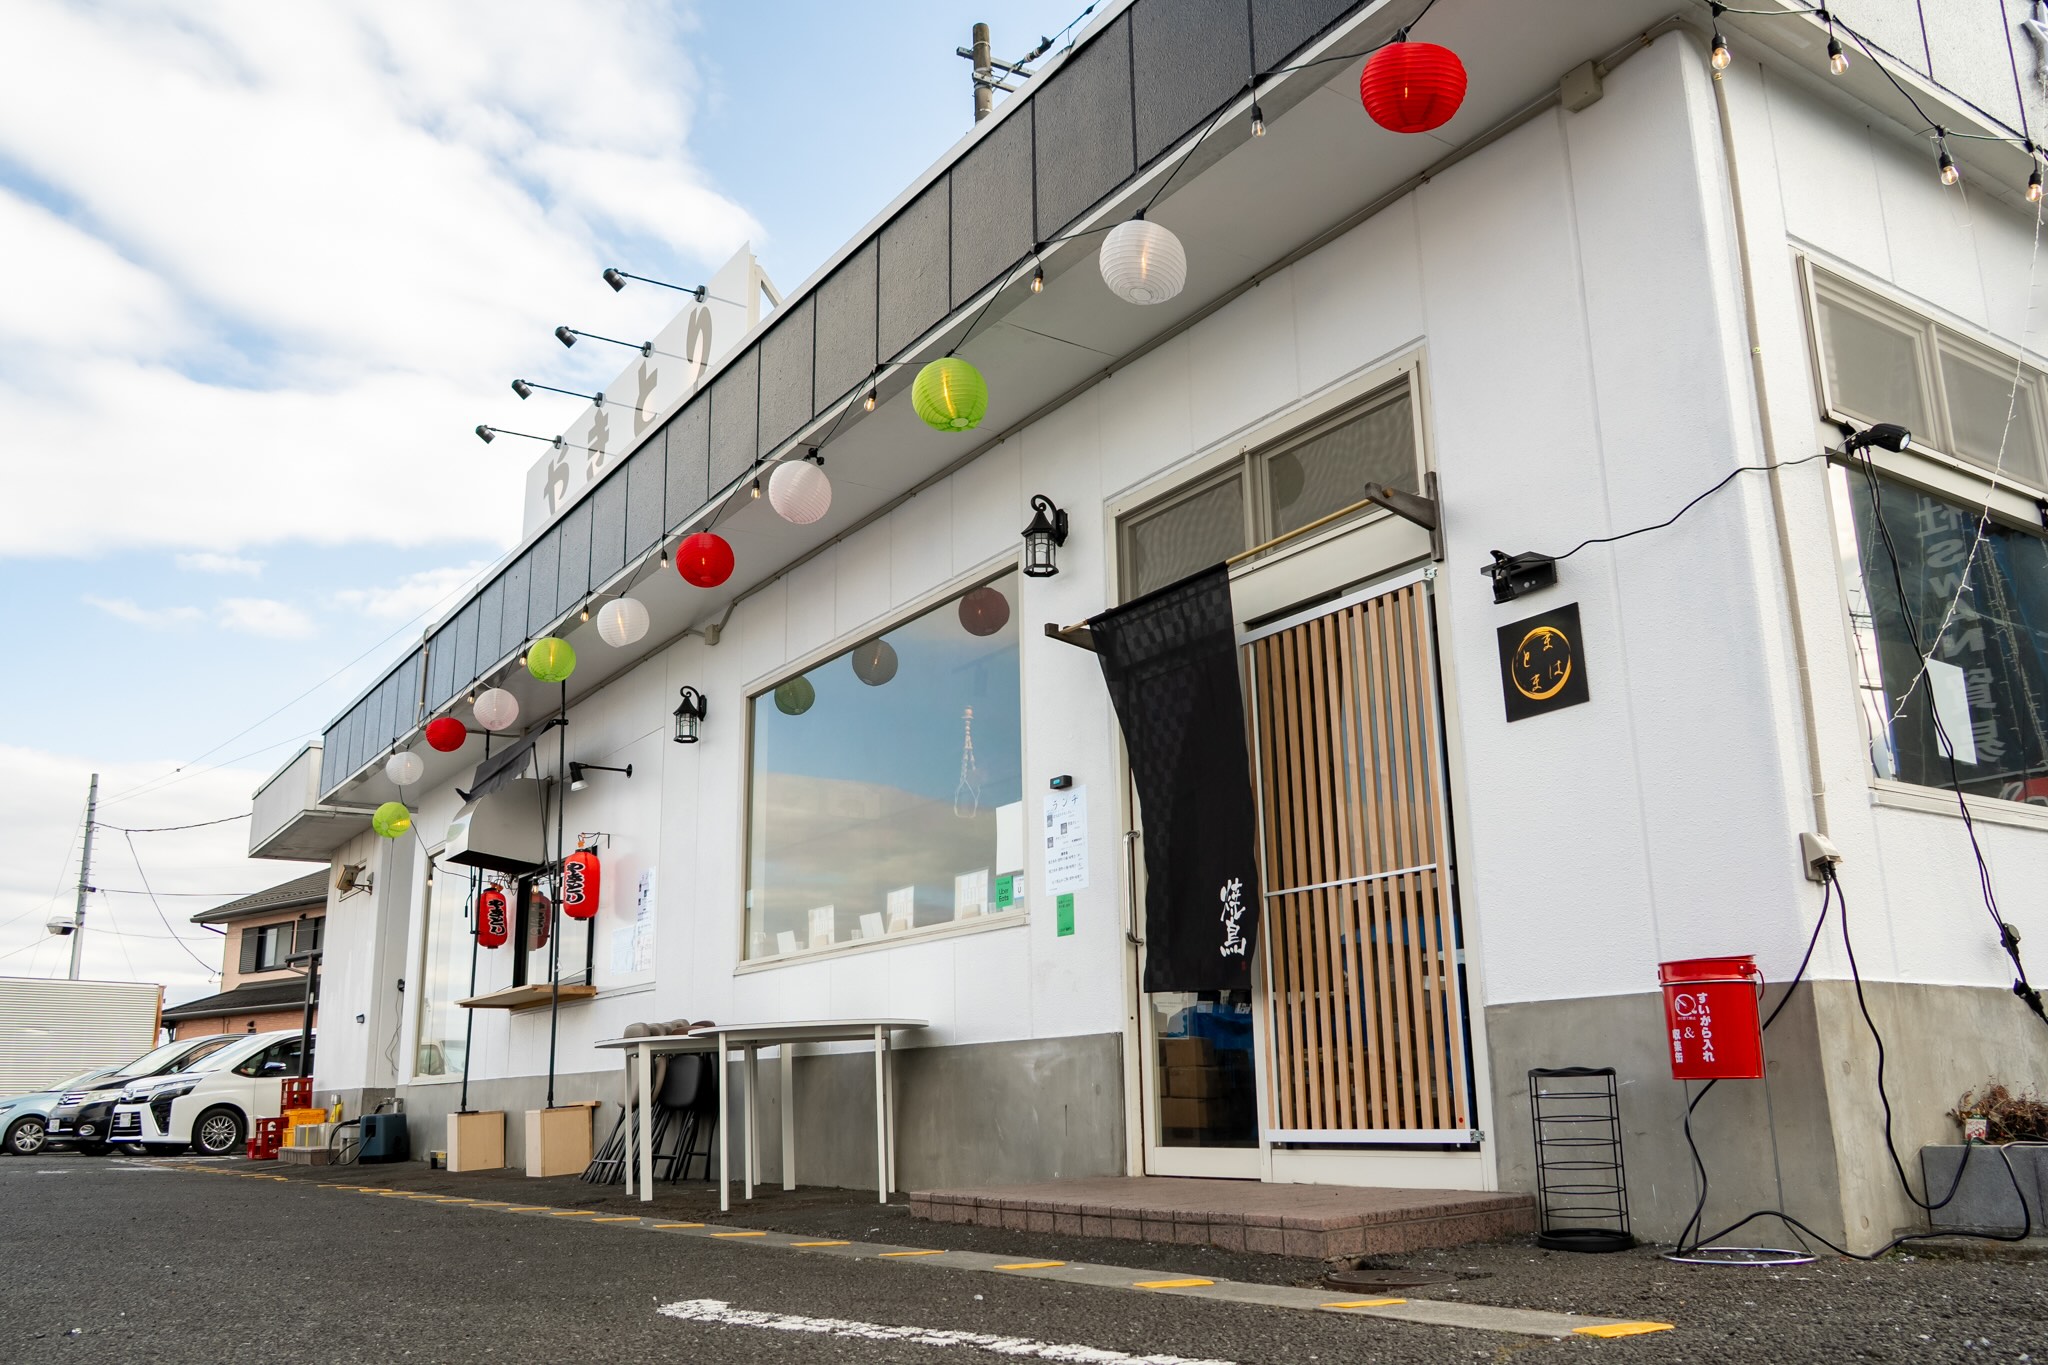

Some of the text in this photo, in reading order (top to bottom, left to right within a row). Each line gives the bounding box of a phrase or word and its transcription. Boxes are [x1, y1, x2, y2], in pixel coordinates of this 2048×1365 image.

[1052, 793, 1079, 810] ランチ
[565, 861, 586, 905] やきとり
[998, 895, 1009, 903] Eats
[487, 898, 506, 936] やきとり
[1684, 1026, 1695, 1039] &
[1696, 992, 1715, 1062] すいがら入れ
